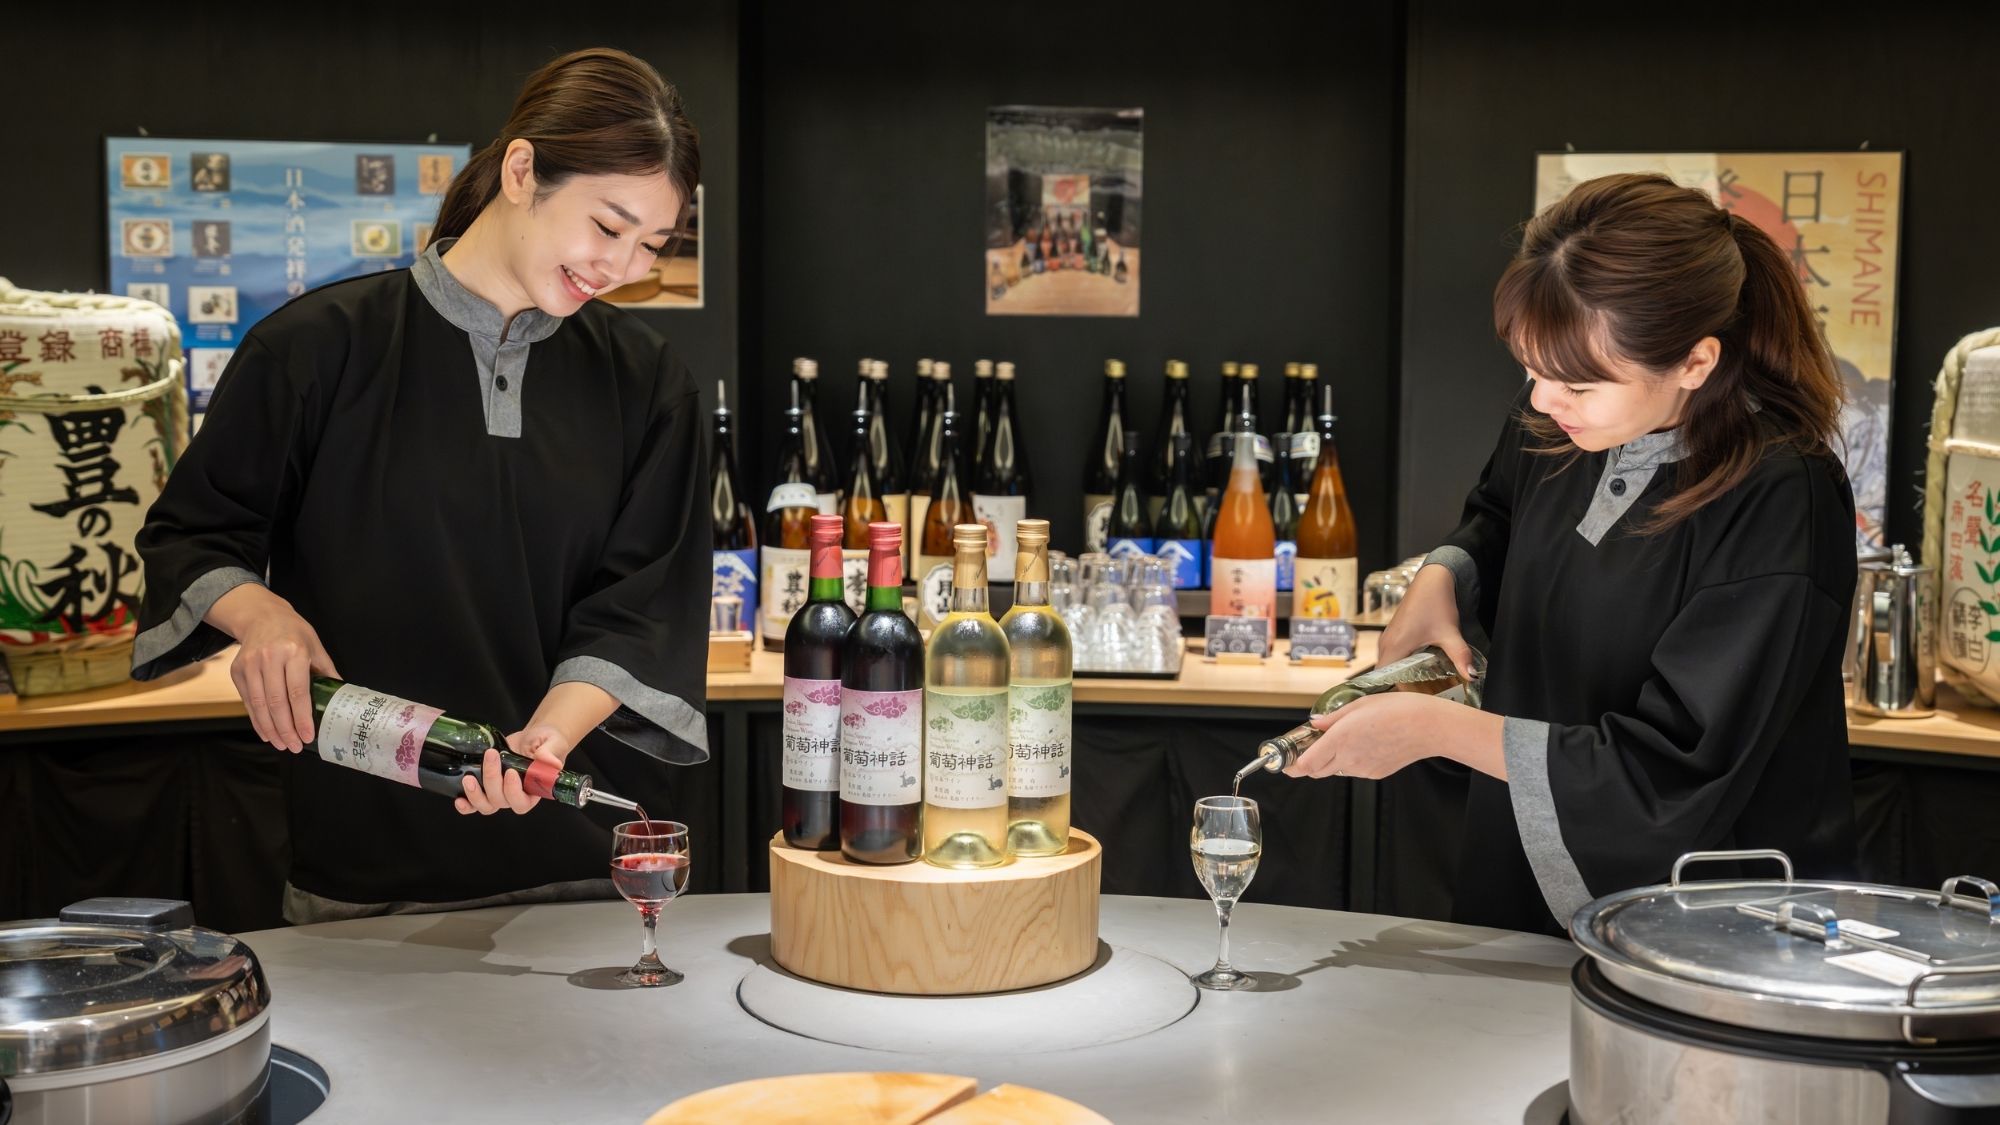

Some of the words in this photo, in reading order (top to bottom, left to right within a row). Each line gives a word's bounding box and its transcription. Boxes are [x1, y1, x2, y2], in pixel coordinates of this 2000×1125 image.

[1850, 170, 1887, 327] SHIMANE
[353, 696, 387, 759] 葡萄神話
[843, 747, 907, 767] 葡萄神話
[929, 751, 995, 771] 葡萄神話
